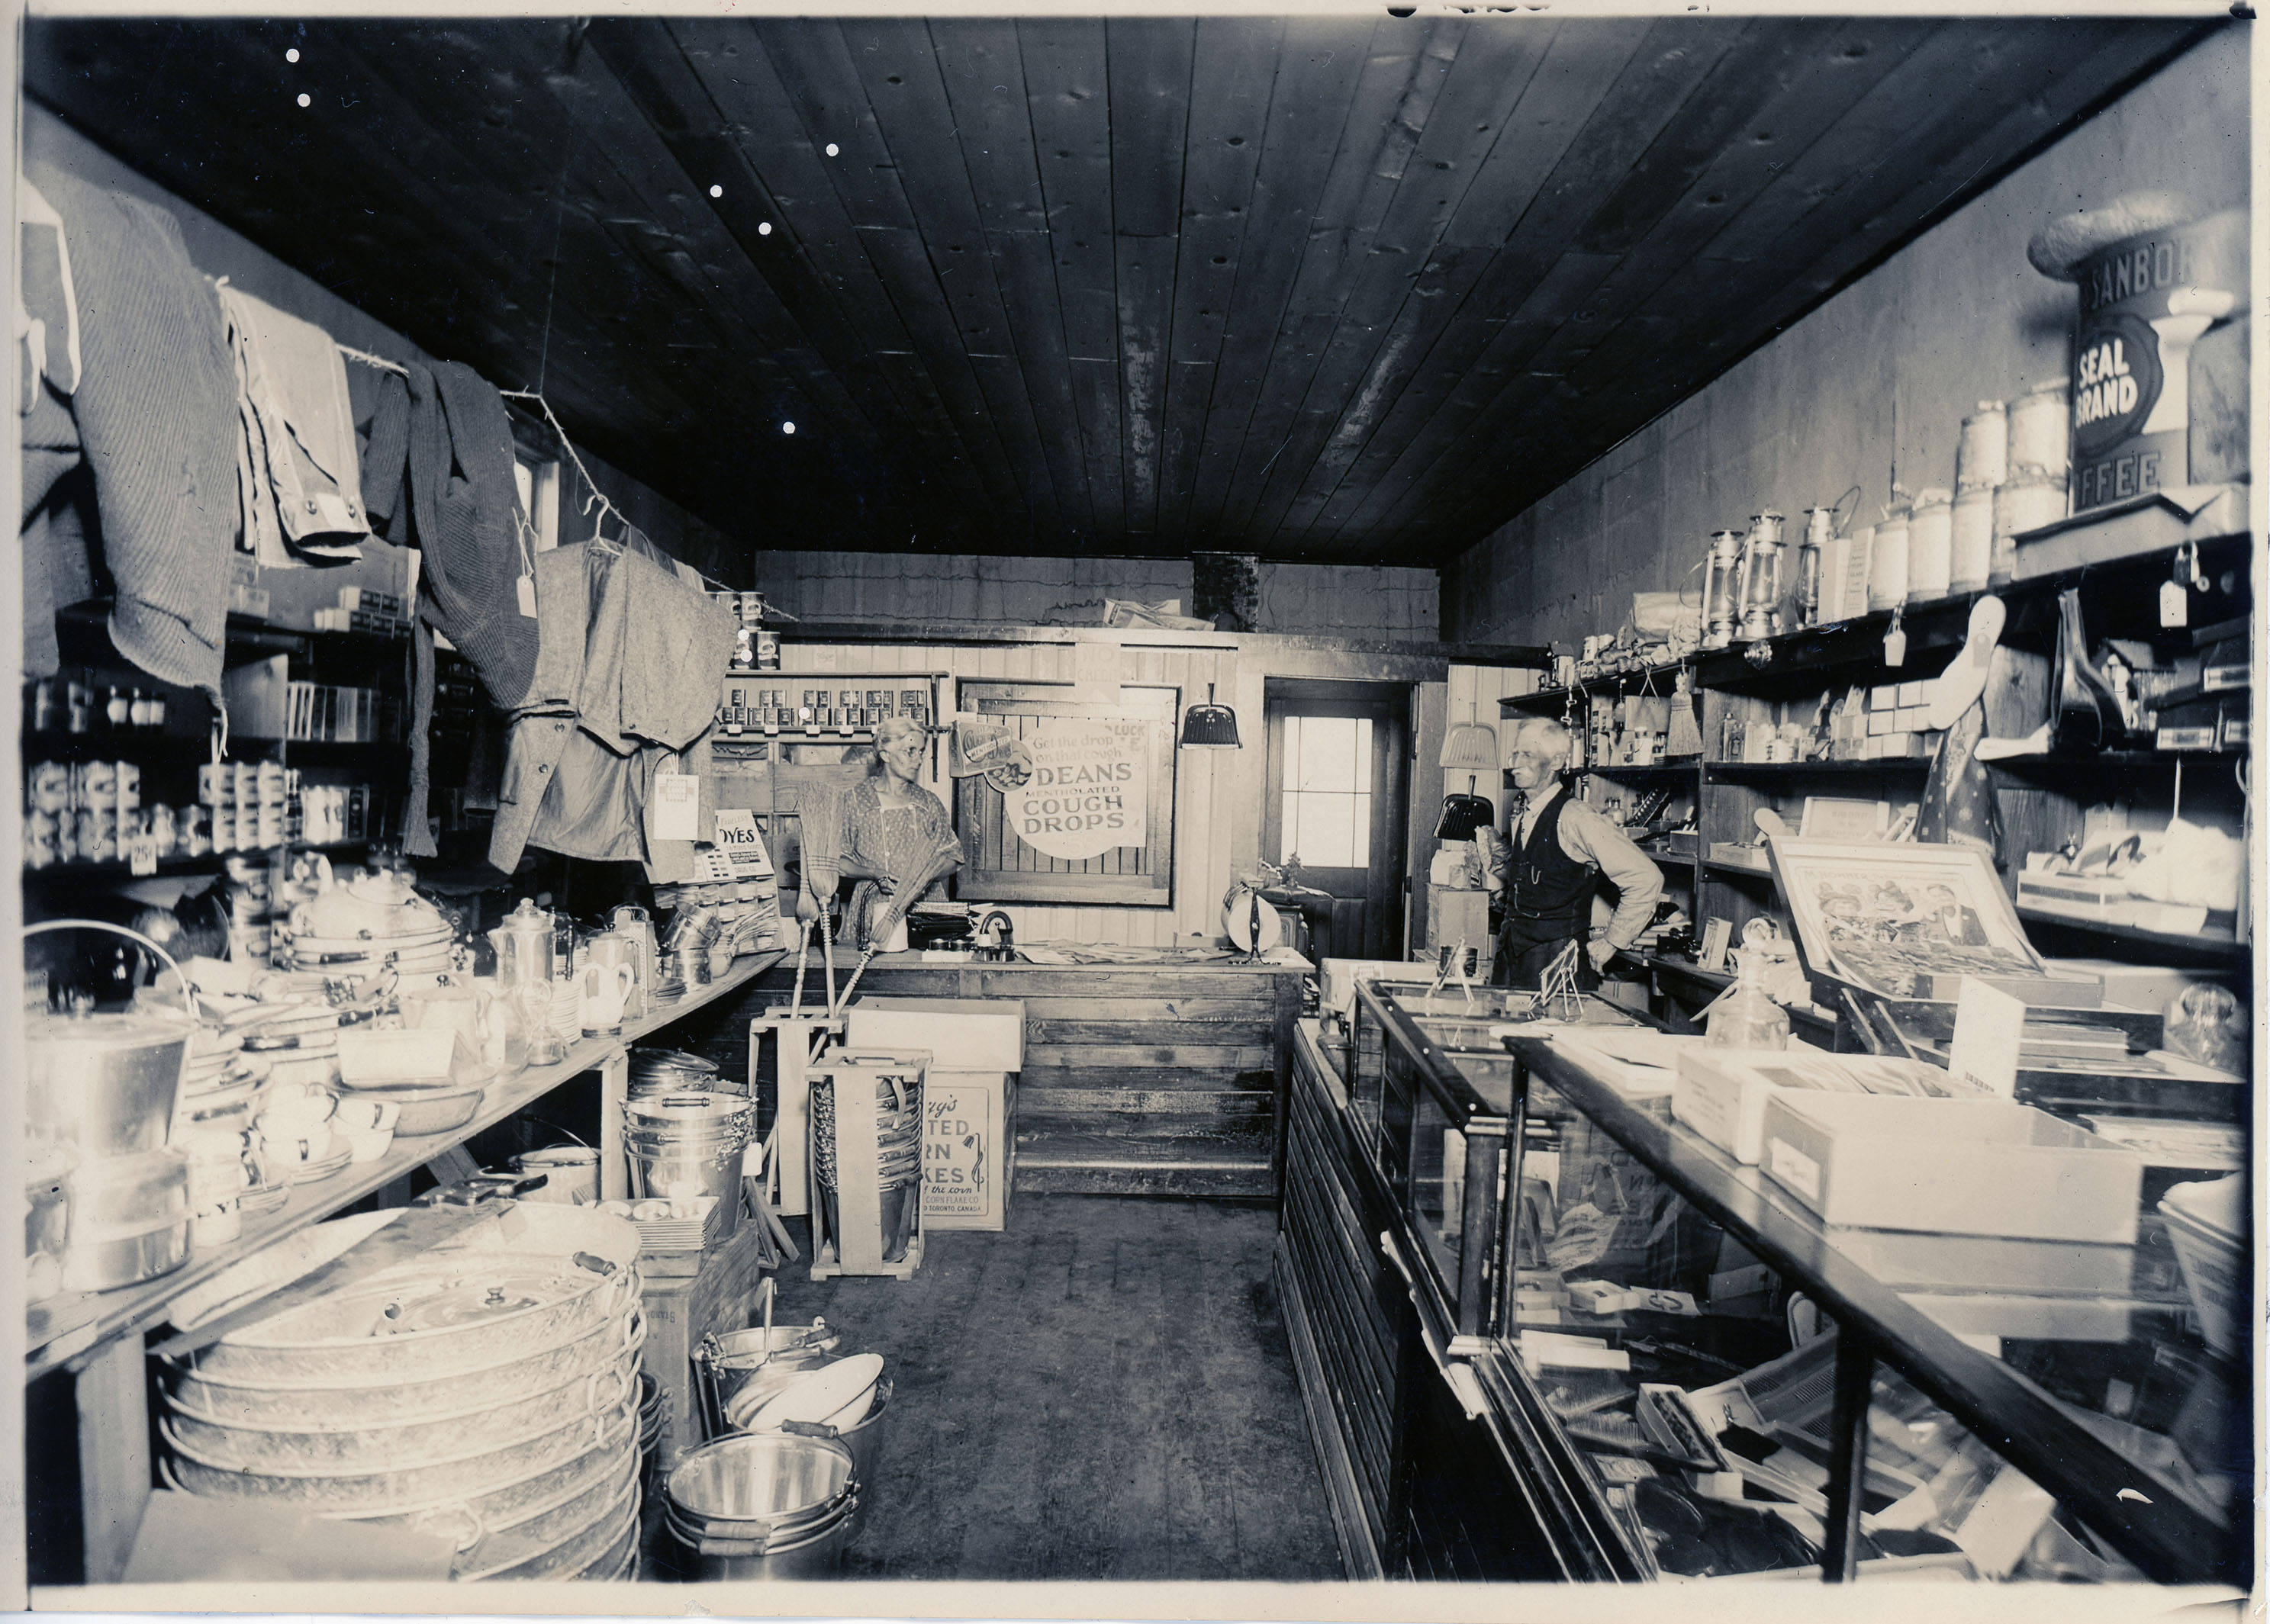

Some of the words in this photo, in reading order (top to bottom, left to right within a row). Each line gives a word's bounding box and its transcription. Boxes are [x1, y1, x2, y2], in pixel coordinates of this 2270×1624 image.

[2078, 338, 2130, 388] SEAL
[2075, 375, 2139, 429] BRAND
[1080, 734, 1114, 748] drop
[1084, 748, 1122, 763] cough
[1035, 763, 1132, 786] DEANS
[1026, 786, 1120, 798] MENTHOLATED
[1022, 795, 1123, 815] COUGH
[1024, 812, 1125, 835] DROPS
[928, 1120, 969, 1136] TED
[932, 1185, 946, 1194] the
[926, 1195, 945, 1204] CORN
[946, 1195, 967, 1204] FLAKE
